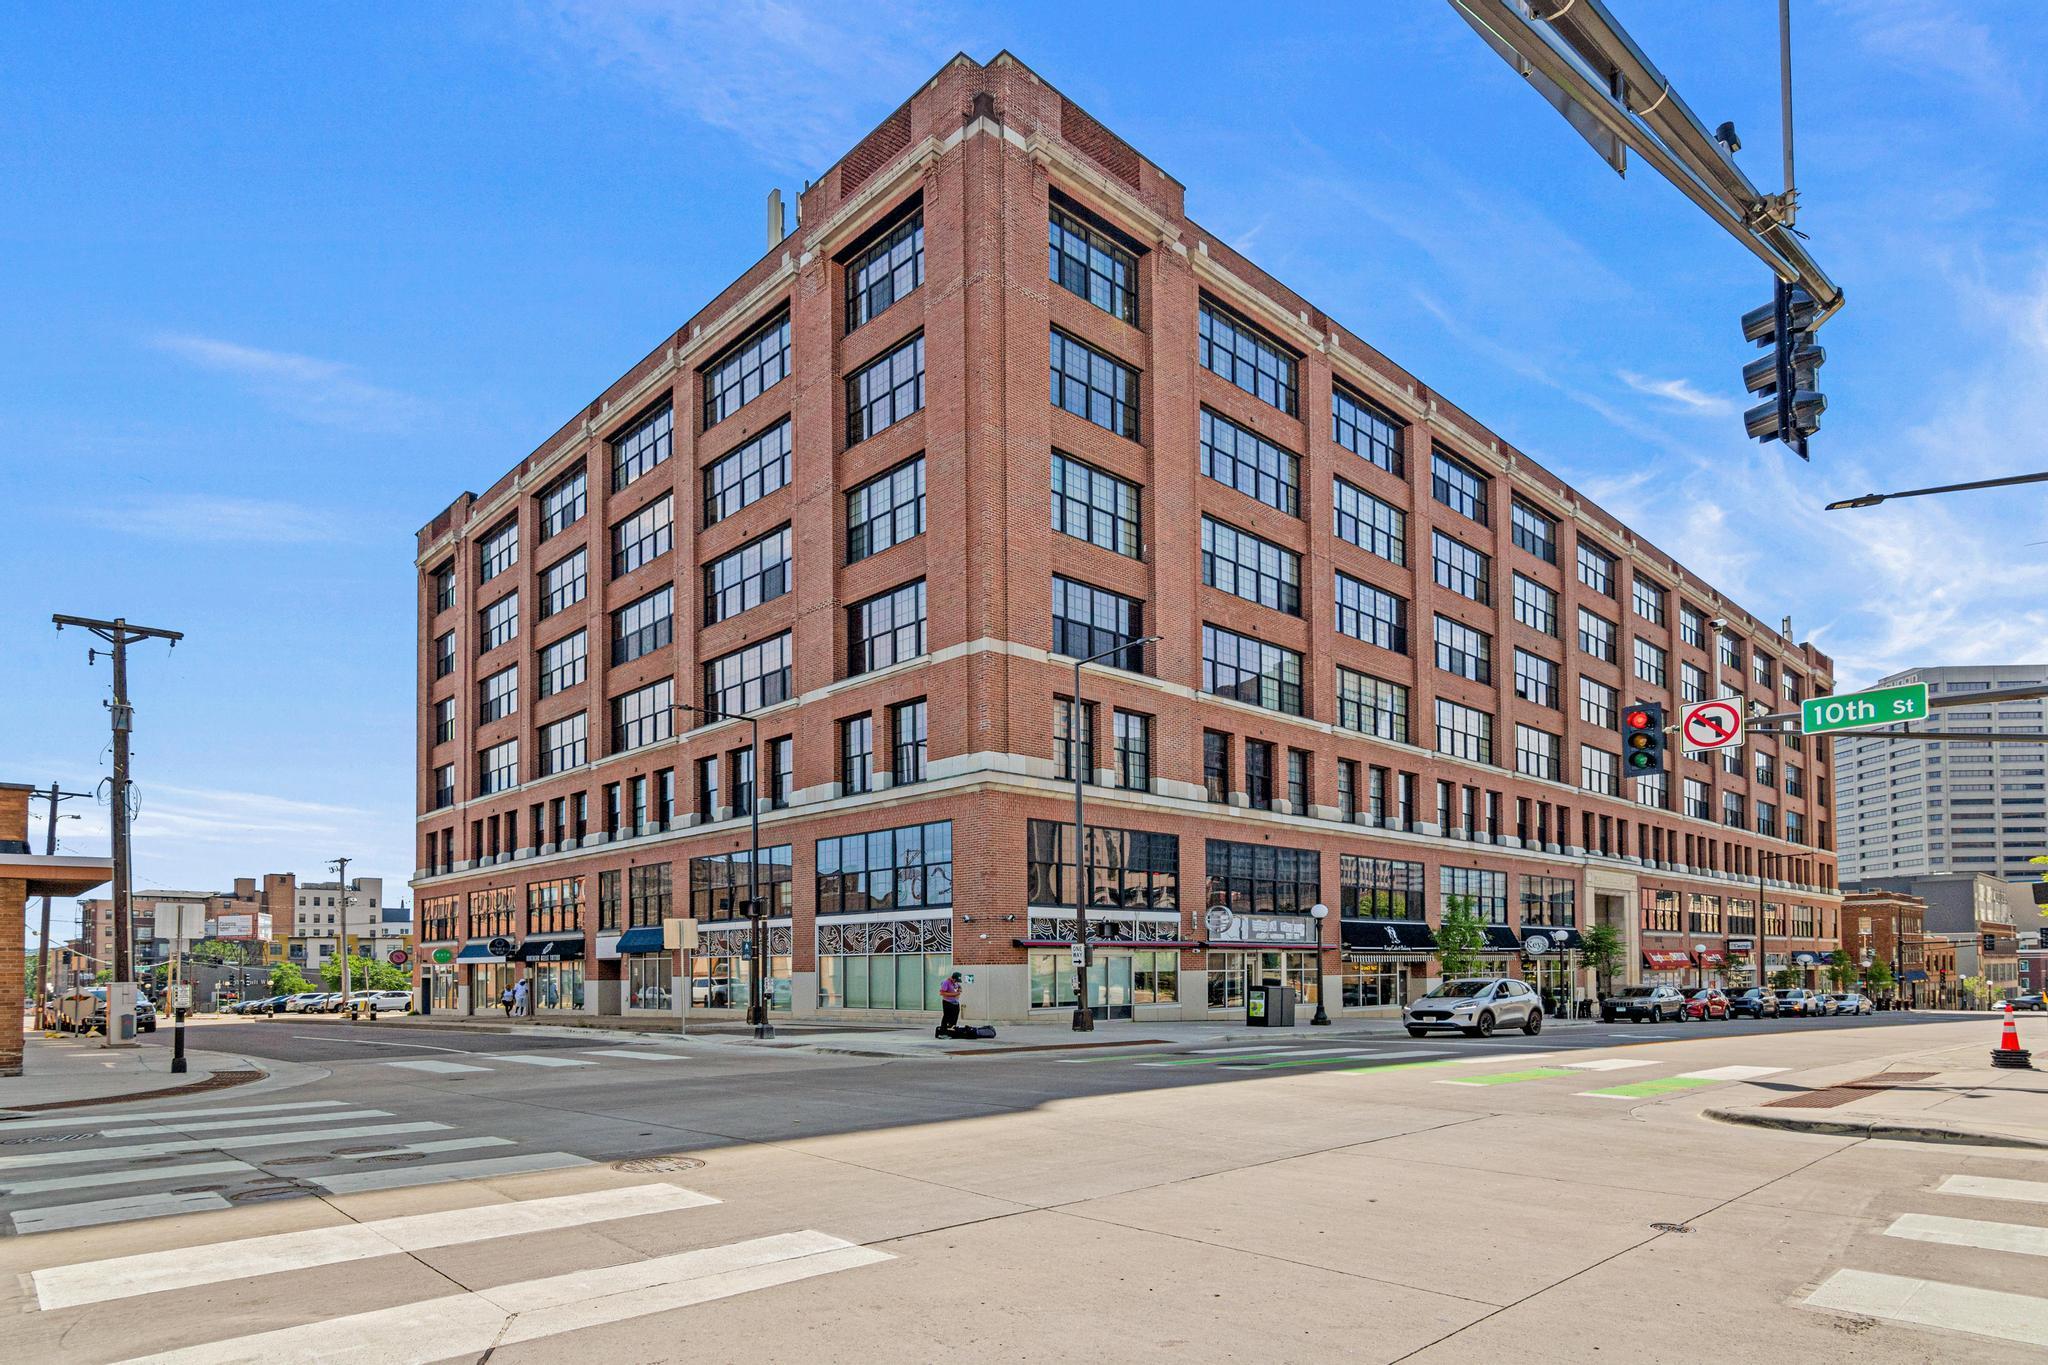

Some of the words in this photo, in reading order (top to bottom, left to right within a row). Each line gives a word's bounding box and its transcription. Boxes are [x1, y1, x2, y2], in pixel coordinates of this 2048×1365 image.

[1813, 699, 1875, 725] 10th
[1892, 698, 1914, 715] St
[1526, 941, 1547, 950] Keys
